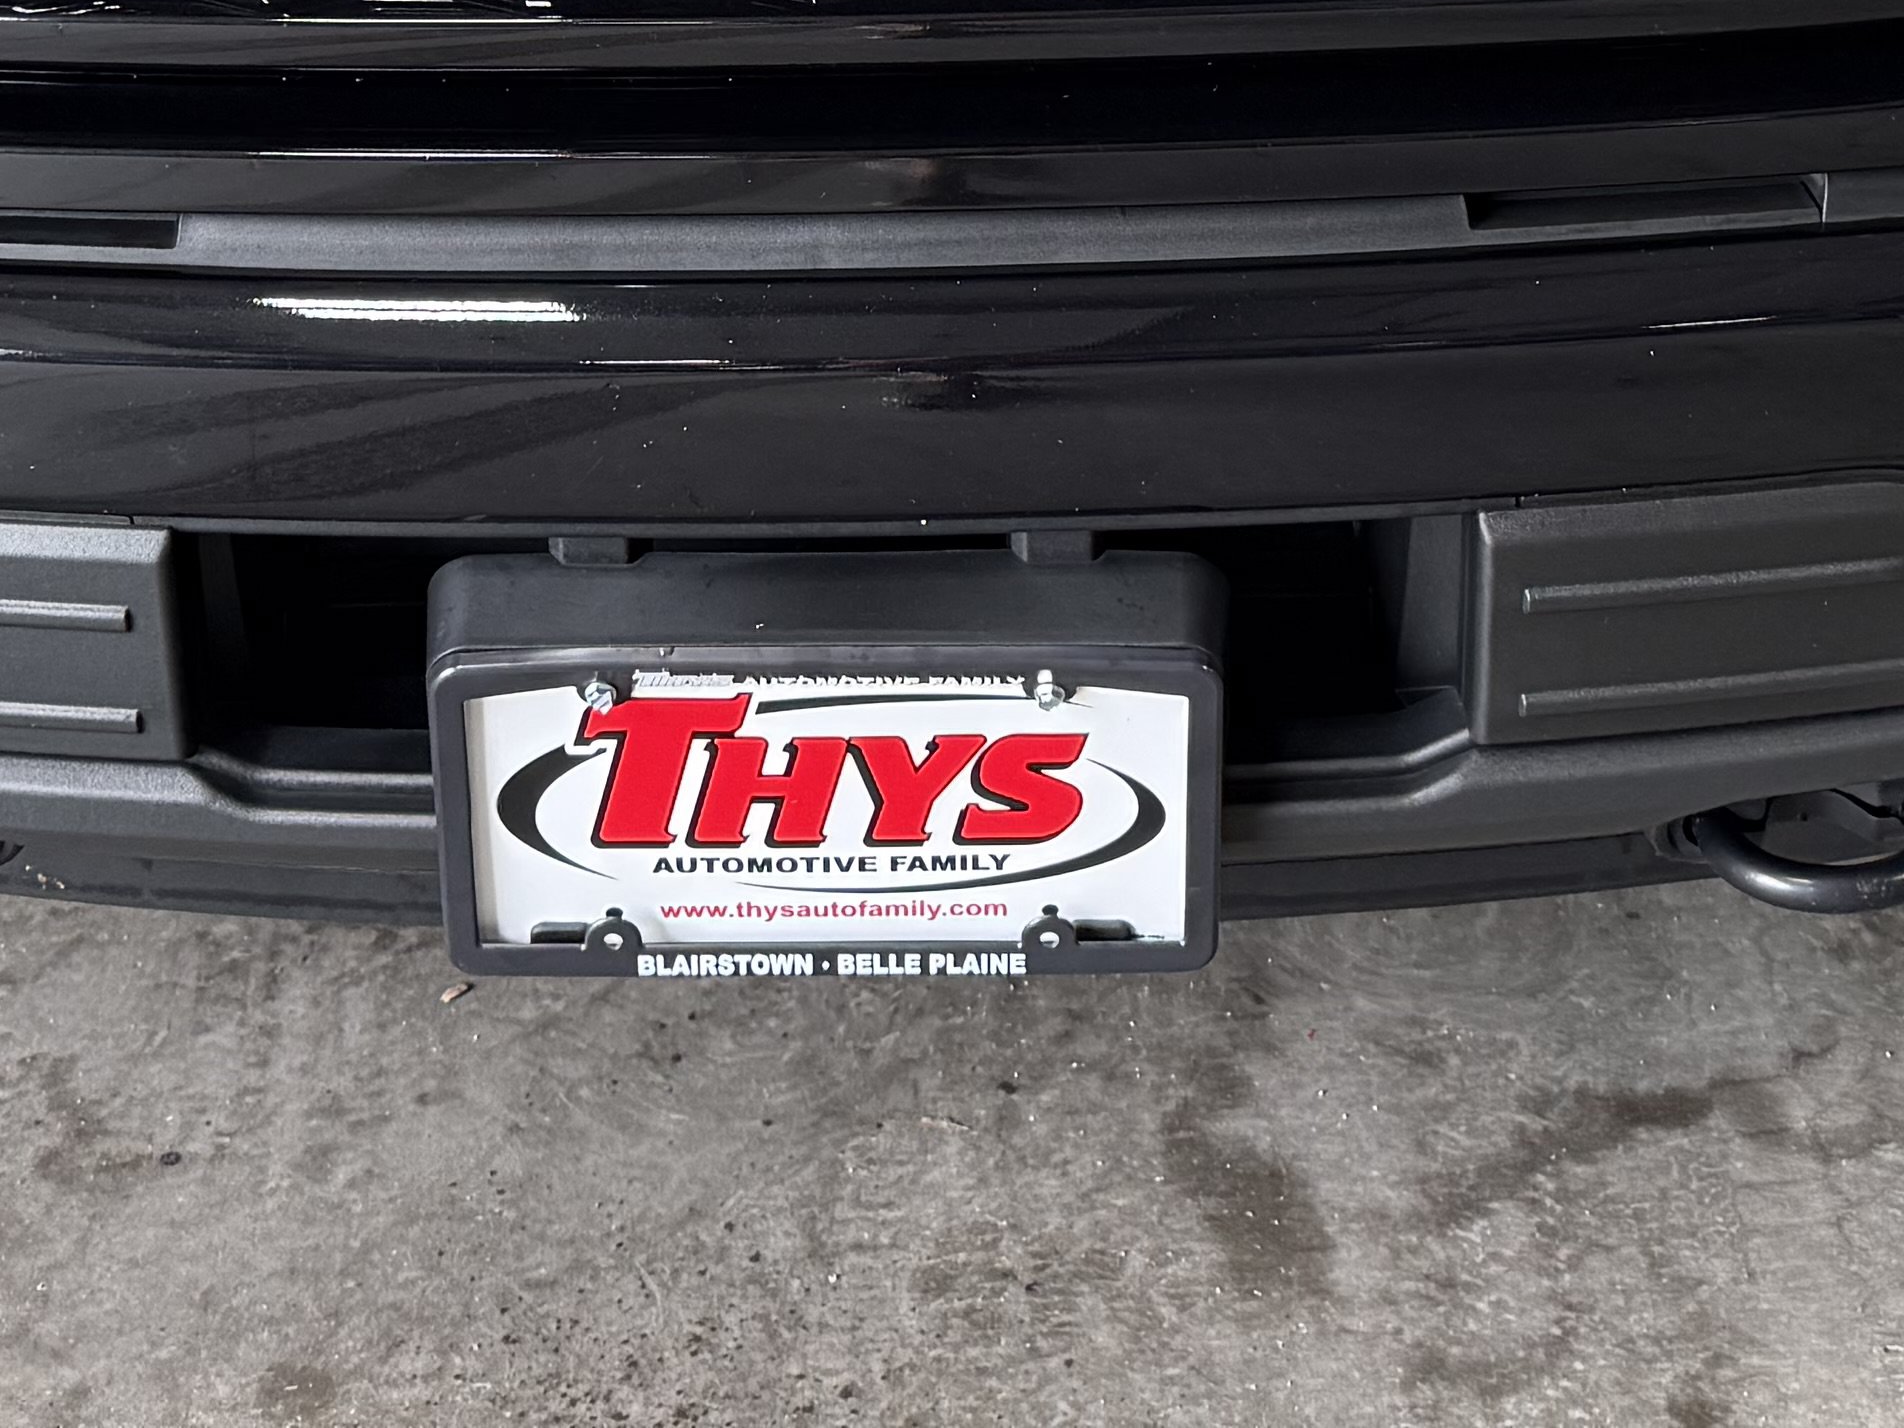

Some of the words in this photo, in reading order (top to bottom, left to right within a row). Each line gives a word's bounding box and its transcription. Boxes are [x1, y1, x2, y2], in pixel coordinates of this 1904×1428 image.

[575, 692, 1090, 850] THYS
[651, 855, 878, 874] AUTOMOTIVE
[889, 853, 1012, 872] FAMILY
[660, 899, 1009, 923] www.thysautofamily.com
[637, 953, 814, 977] BLAIRSTOWN
[836, 953, 921, 976] BELLE
[928, 952, 1027, 975] PLAINE
